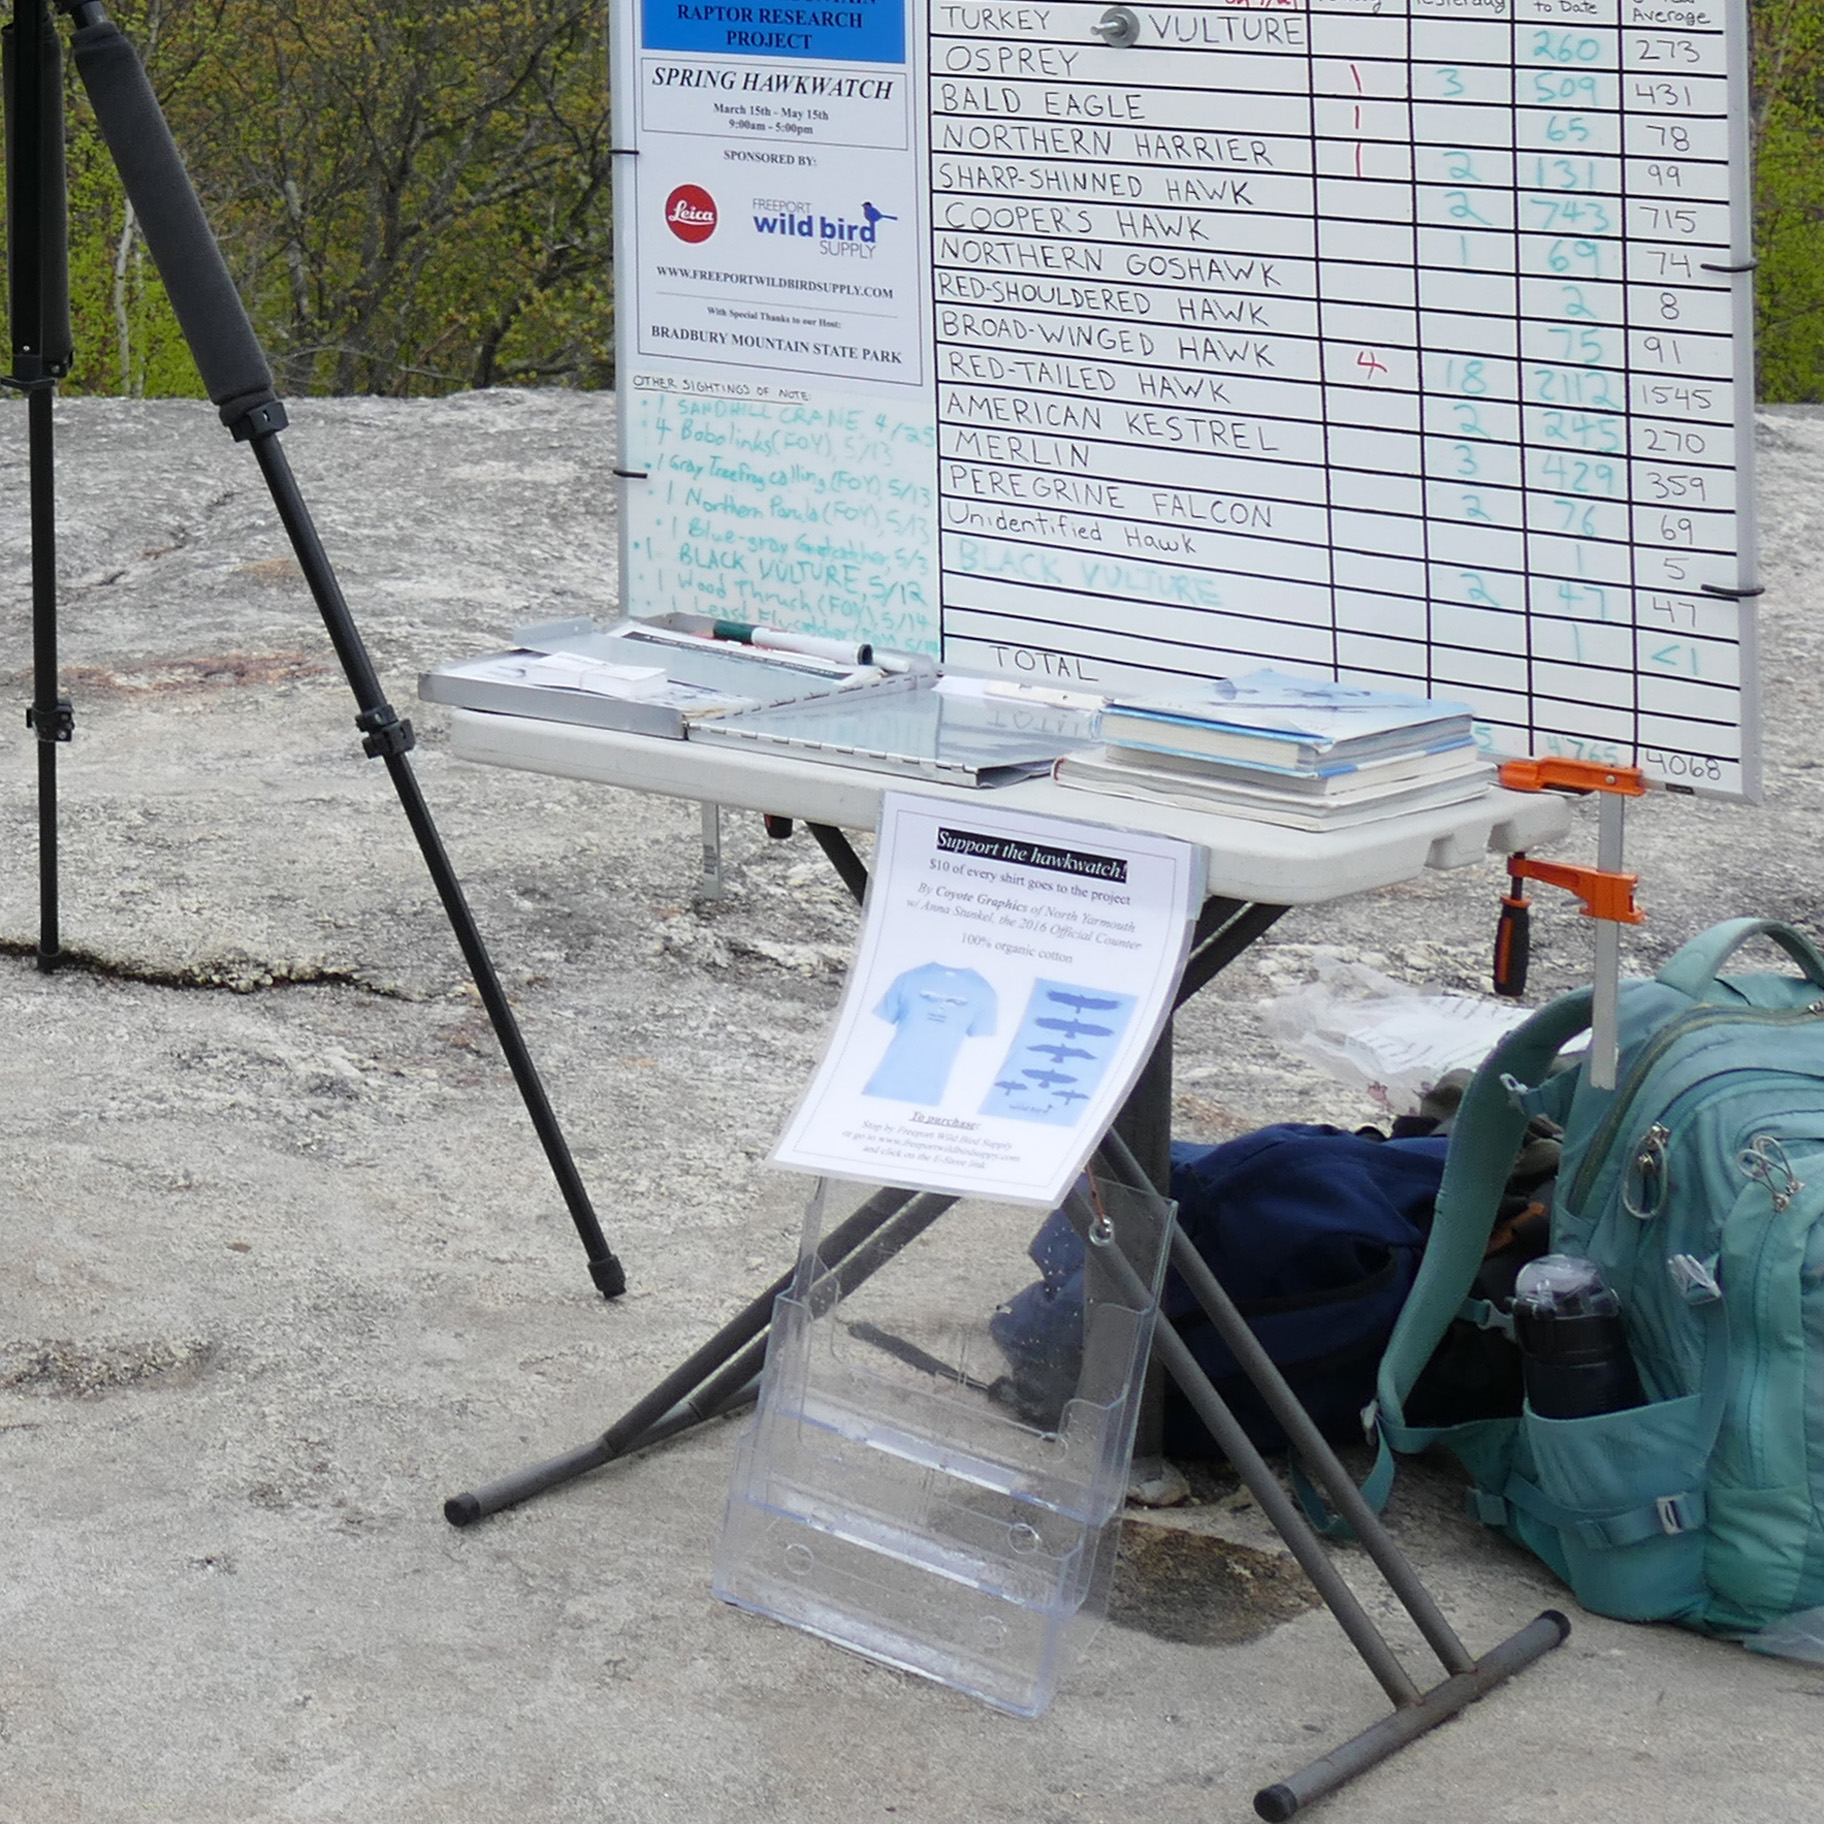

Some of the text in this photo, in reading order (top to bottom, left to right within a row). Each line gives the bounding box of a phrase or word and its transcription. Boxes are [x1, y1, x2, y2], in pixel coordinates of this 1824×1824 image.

[678, 5, 862, 28] RAPTOR RESEARCH
[1535, 0, 1598, 14] to Date
[1633, 9, 1712, 25] Average
[726, 30, 812, 49] PROJECT
[940, 6, 1305, 45] TURKEY VULTURE
[945, 45, 1079, 76] OSPREY
[1532, 31, 1600, 62] 260
[1636, 40, 1701, 63] 273
[652, 66, 894, 99] SPRING HAWKWATCH
[1436, 69, 1465, 97] 3
[1536, 73, 1597, 104] 509
[1635, 83, 1691, 106] 431
[713, 103, 828, 120] March 15th May 15th
[941, 83, 1146, 120] BALD EAGLE
[729, 120, 813, 136] 9:00am 5:00pm
[1546, 116, 1590, 142] 65
[1647, 125, 1690, 152] 78
[724, 150, 817, 166] SPONSORED BY:
[942, 124, 1274, 166] NORTHERN HARRIER
[1443, 151, 1481, 182] 2
[1537, 157, 1596, 189] 131
[1648, 166, 1681, 187] 99
[938, 163, 1253, 205] SHARP-SHINNED HAWK
[669, 200, 714, 225] Leica
[753, 199, 812, 213] FREEPORT
[945, 202, 1209, 241] COOPER'S HAWK
[1444, 191, 1492, 225] 2
[1531, 199, 1610, 232] 743
[1640, 206, 1697, 234] 715
[753, 214, 876, 242] wild bird
[820, 241, 876, 259] SUPPLY
[941, 237, 1281, 287] NORTHERN GOSHAWK
[1548, 239, 1600, 278] 69
[1647, 251, 1692, 277] 74
[657, 266, 893, 299] WWW.FREEPORTWILDBIRDSUPPLY.COM
[707, 306, 727, 317] With
[729, 308, 758, 321] Special
[760, 312, 790, 323] Thanks
[938, 272, 1269, 327] RED-SHOULDERED HAWK
[1562, 286, 1597, 318] 2
[1660, 293, 1680, 320] 8
[651, 326, 902, 364] BRADBURY MOUNTAIN STATE PARK
[941, 310, 1275, 368] BROAD-WINGED HAWK
[1548, 329, 1602, 364] 75
[1644, 336, 1681, 364] 91
[949, 351, 1231, 404] RED-TAILED HAWK
[1357, 350, 1388, 380] 4
[1447, 359, 1486, 395] 18
[633, 375, 676, 389] OTHER
[682, 379, 751, 394] SIGHTINGS
[756, 386, 770, 395] OF
[1534, 370, 1622, 409] 2112
[1642, 384, 1712, 411] 1545
[677, 399, 773, 420] SANDHILL
[947, 392, 1279, 452] AMERICAN KESTREL
[1454, 405, 1490, 439] 2
[1543, 412, 1619, 453] 245
[1644, 428, 1705, 454] 270
[955, 430, 1090, 468] MERLIN
[1455, 445, 1476, 476] 3
[1542, 454, 1614, 493] 429
[1647, 473, 1706, 501] 359
[950, 465, 1273, 527] PEREGRINE FALCON
[1462, 495, 1491, 521] 2
[947, 501, 1197, 554] Unidentified Hawk
[1554, 500, 1595, 537] 76
[1660, 516, 1693, 544] 69
[680, 542, 745, 571] BLACK
[1663, 558, 1690, 580] 5
[959, 538, 1224, 607] BLACK VULTURE
[1460, 573, 1500, 607] 2
[1557, 583, 1605, 620] 47
[1652, 597, 1696, 627] 47
[990, 645, 1099, 682] TOTAL
[1646, 749, 1721, 781] 4068
[939, 831, 1127, 879] Support the hawkwatch!
[929, 859, 1131, 906] $10 of every shirt goes to the project
[918, 882, 1135, 933] By Coyote Graphics of North Yarmouth
[921, 902, 1142, 950] Anna the 2016 Official Counter
[961, 932, 1073, 964] 100% organic cotton
